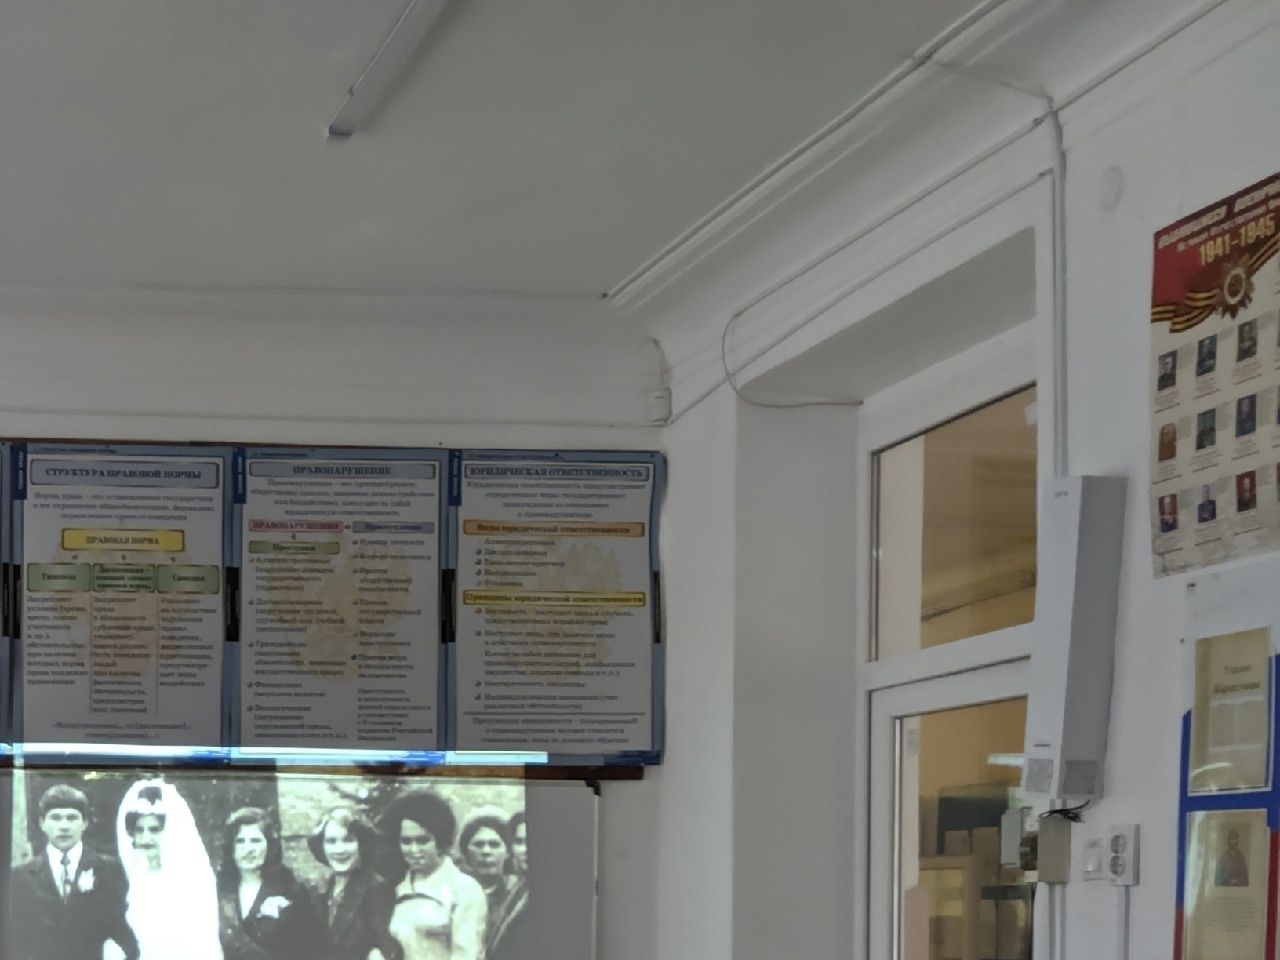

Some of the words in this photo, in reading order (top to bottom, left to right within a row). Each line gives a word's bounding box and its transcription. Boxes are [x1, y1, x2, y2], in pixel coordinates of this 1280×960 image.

[45, 467, 106, 478] СТРУКТУРА
[107, 469, 162, 479] ПРАВОВОЙ
[164, 470, 202, 479] НОРМЫ
[293, 466, 392, 476] ПРАВОНАРУШЕНИЕ
[470, 467, 548, 476] ЮРИДИЧЕСКАЯ
[549, 468, 643, 478] ОТВЕТСТВЕННОСТЬ
[86, 536, 130, 544] ПРАВОВАЯ
[131, 536, 160, 545] НОРМА
